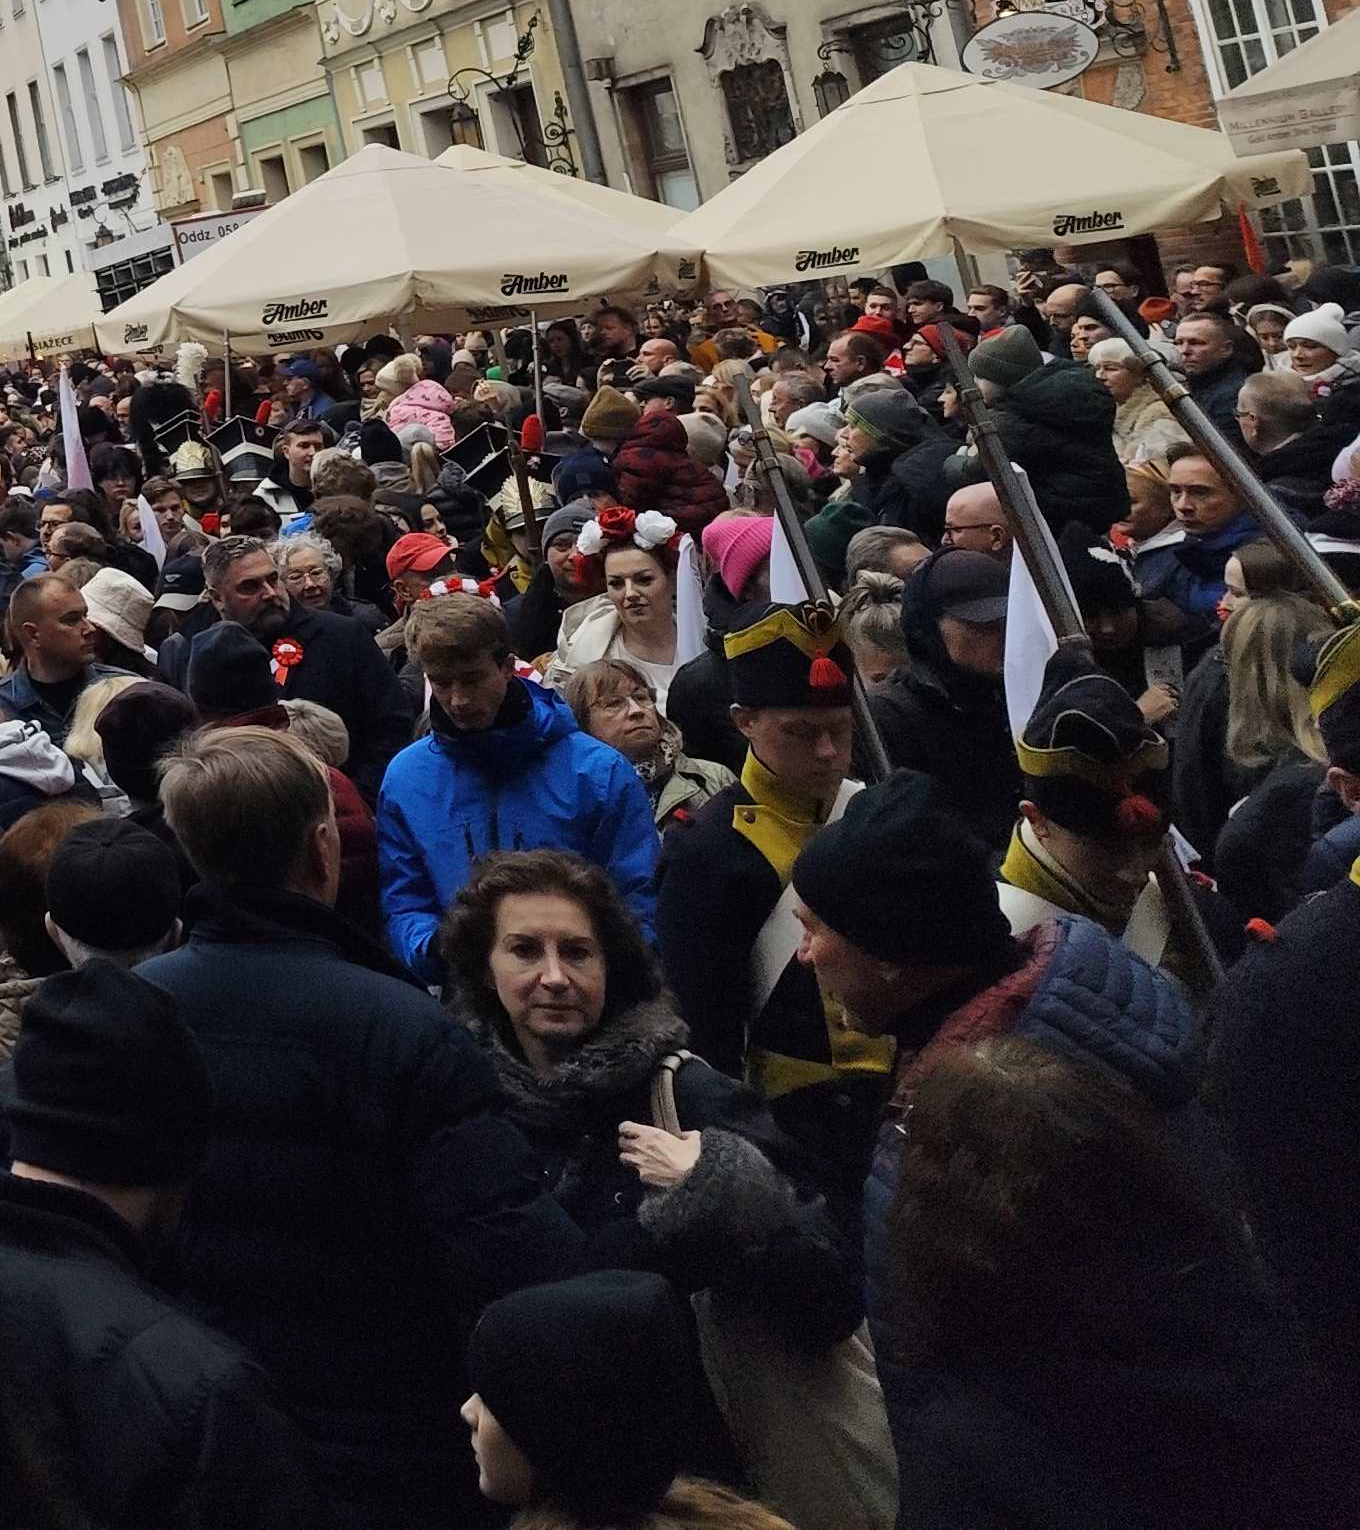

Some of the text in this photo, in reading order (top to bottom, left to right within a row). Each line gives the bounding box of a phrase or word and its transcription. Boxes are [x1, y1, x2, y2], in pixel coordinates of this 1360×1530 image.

[1054, 211, 1125, 236] Amber
[795, 246, 860, 272] Amber
[501, 272, 569, 296] Amber
[262, 298, 328, 325] Amber
